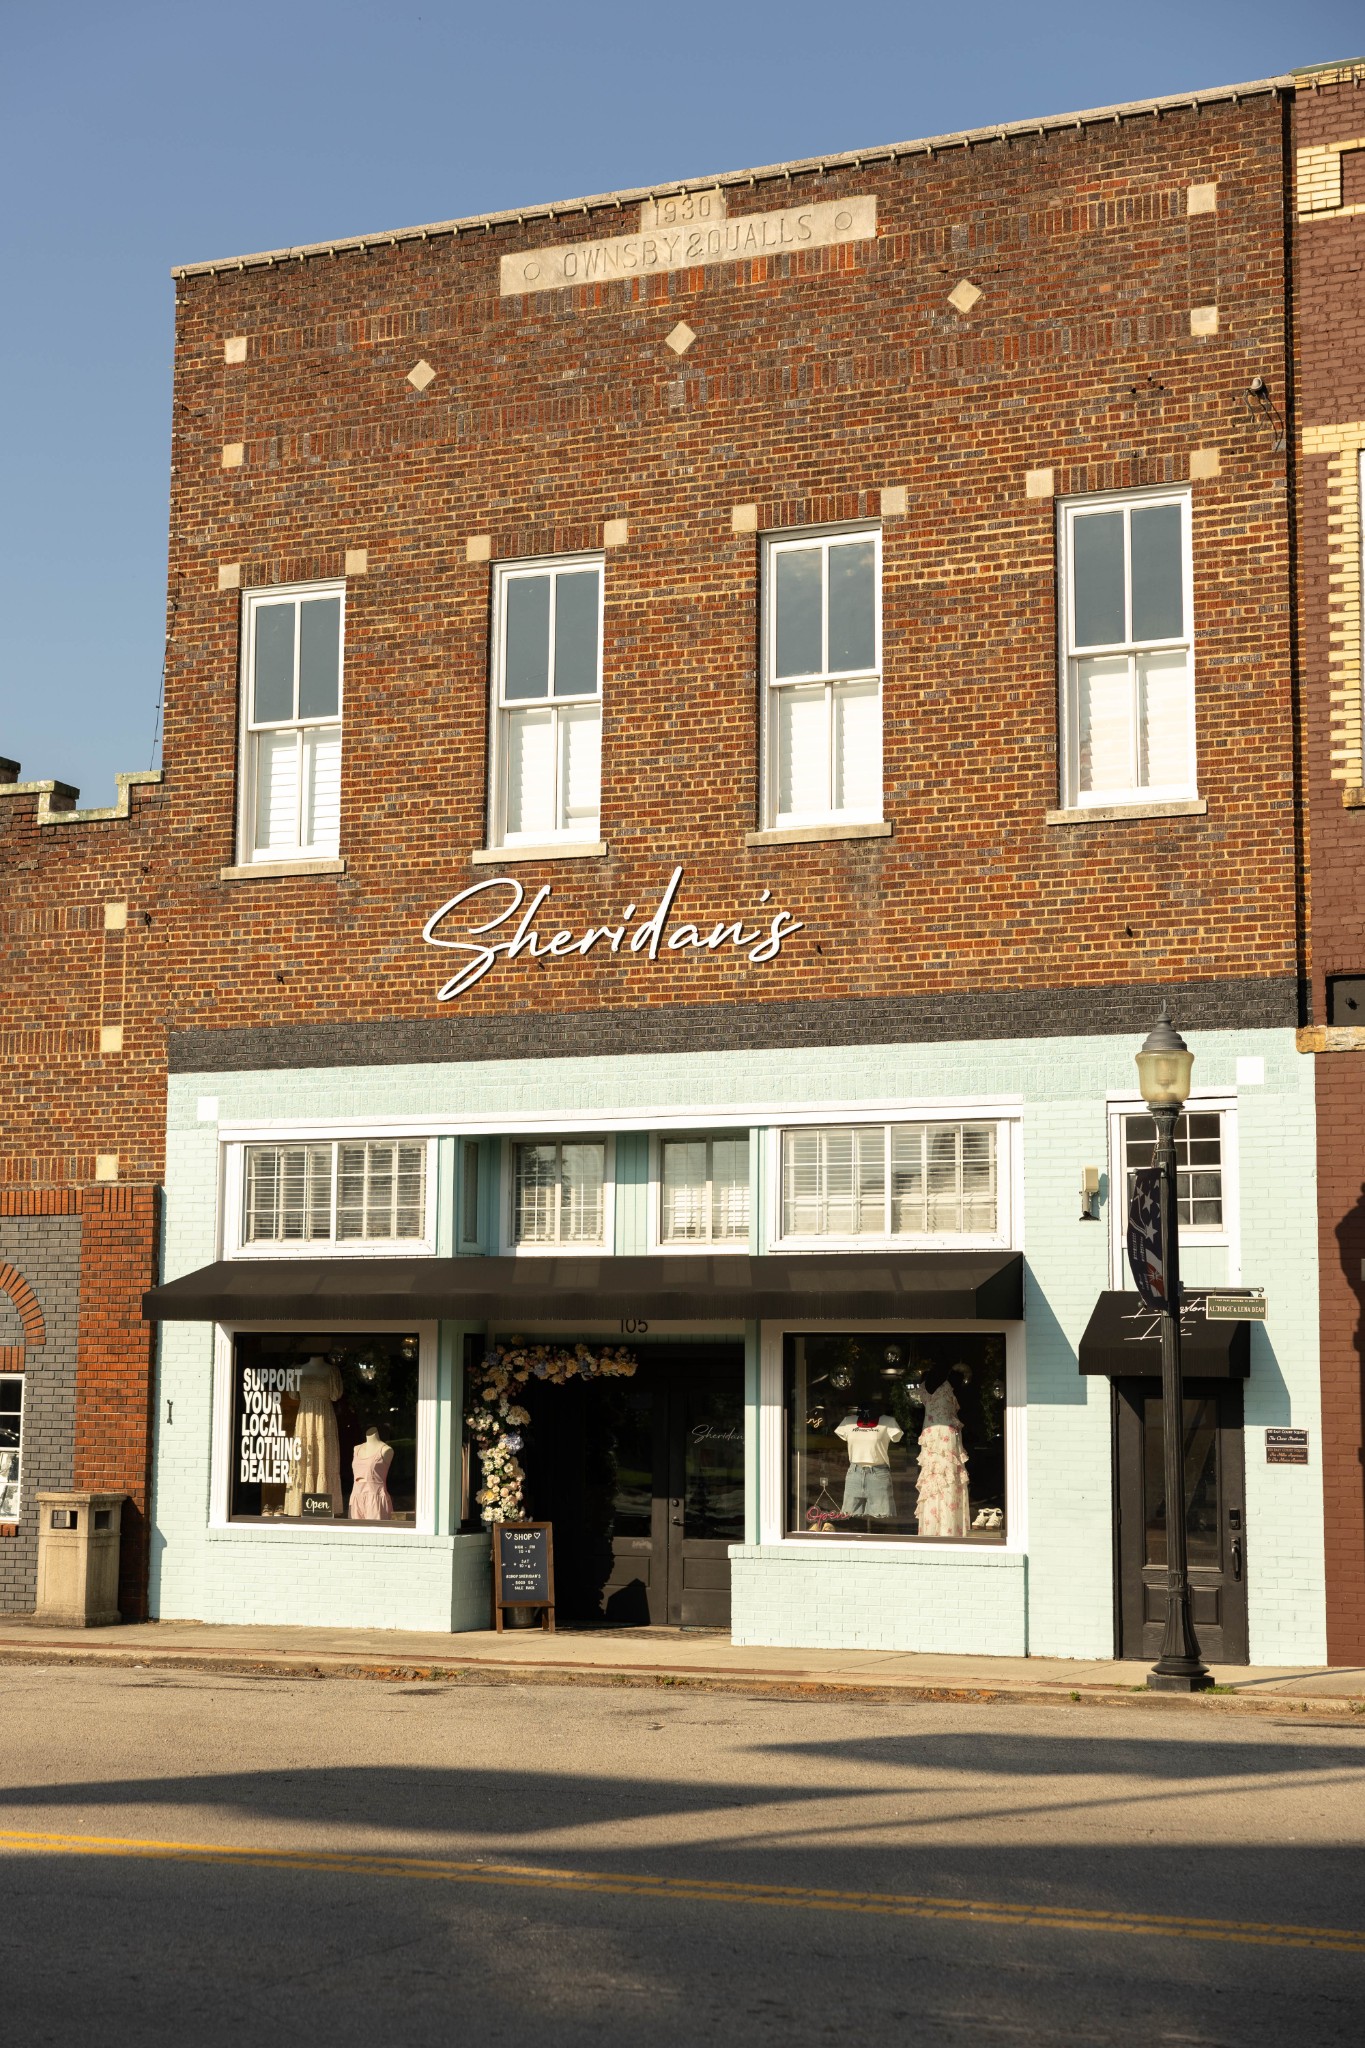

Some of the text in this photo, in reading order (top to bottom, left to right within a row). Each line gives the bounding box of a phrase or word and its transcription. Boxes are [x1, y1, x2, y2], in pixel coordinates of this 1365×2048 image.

[654, 195, 712, 226] 1930
[563, 213, 813, 278] OWNSBY & QUALLS
[422, 865, 804, 1001] Sheridan's
[620, 1319, 648, 1333] 105
[243, 1368, 303, 1392] SUPPORT
[243, 1391, 282, 1414] YOUR
[241, 1413, 286, 1437] LOCAL
[241, 1437, 302, 1460] CLOTHING
[305, 1498, 330, 1513] Open
[806, 1506, 850, 1528] Open
[513, 1533, 532, 1541] SHOP
